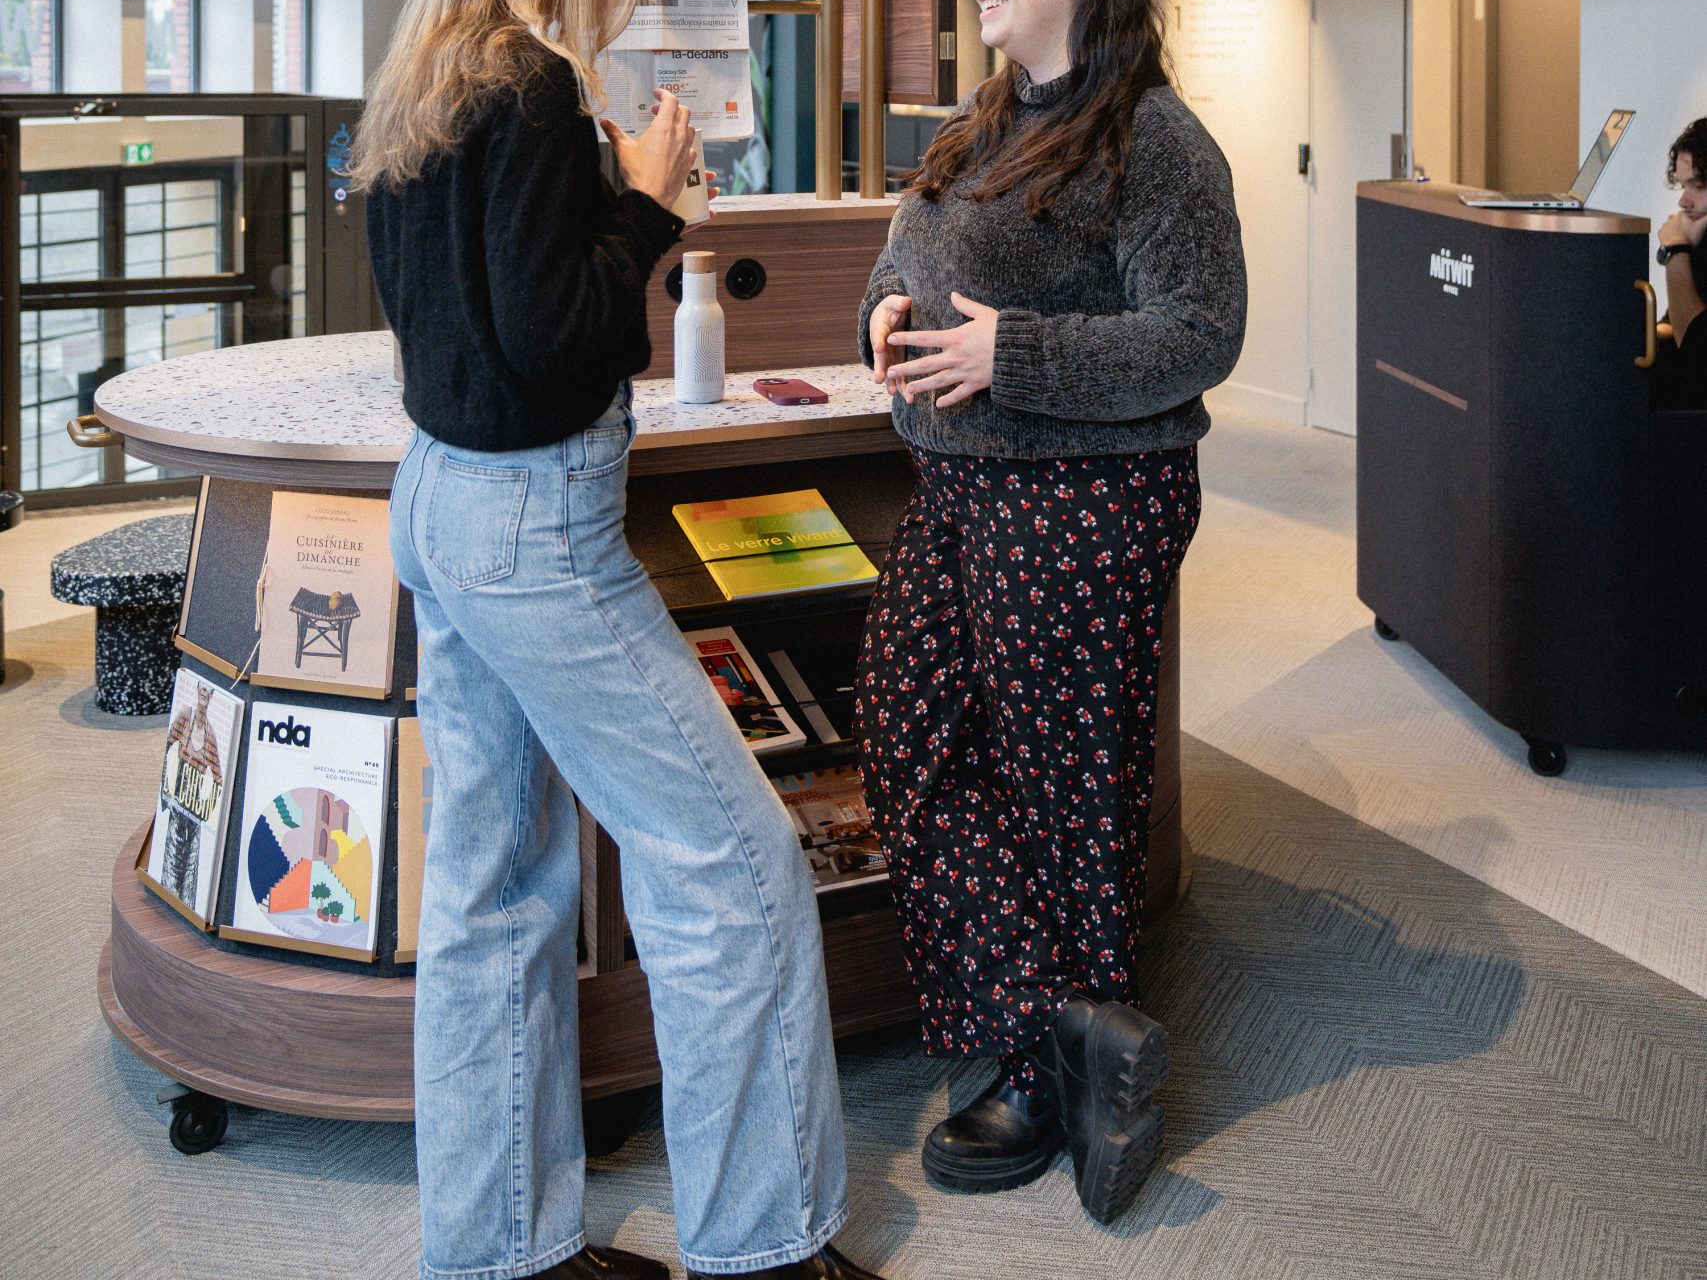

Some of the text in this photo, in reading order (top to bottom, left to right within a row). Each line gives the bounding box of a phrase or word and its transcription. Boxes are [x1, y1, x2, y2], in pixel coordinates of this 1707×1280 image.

[727, 20, 739, 28] Les
[1174, 5, 1181, 31] 1
[296, 535, 364, 551] CUISINIÈRE
[706, 527, 843, 553] Le verre vivant
[296, 551, 361, 567] DIMANCHE
[257, 715, 312, 749] nda
[338, 769, 379, 780] ARCHITECTURE
